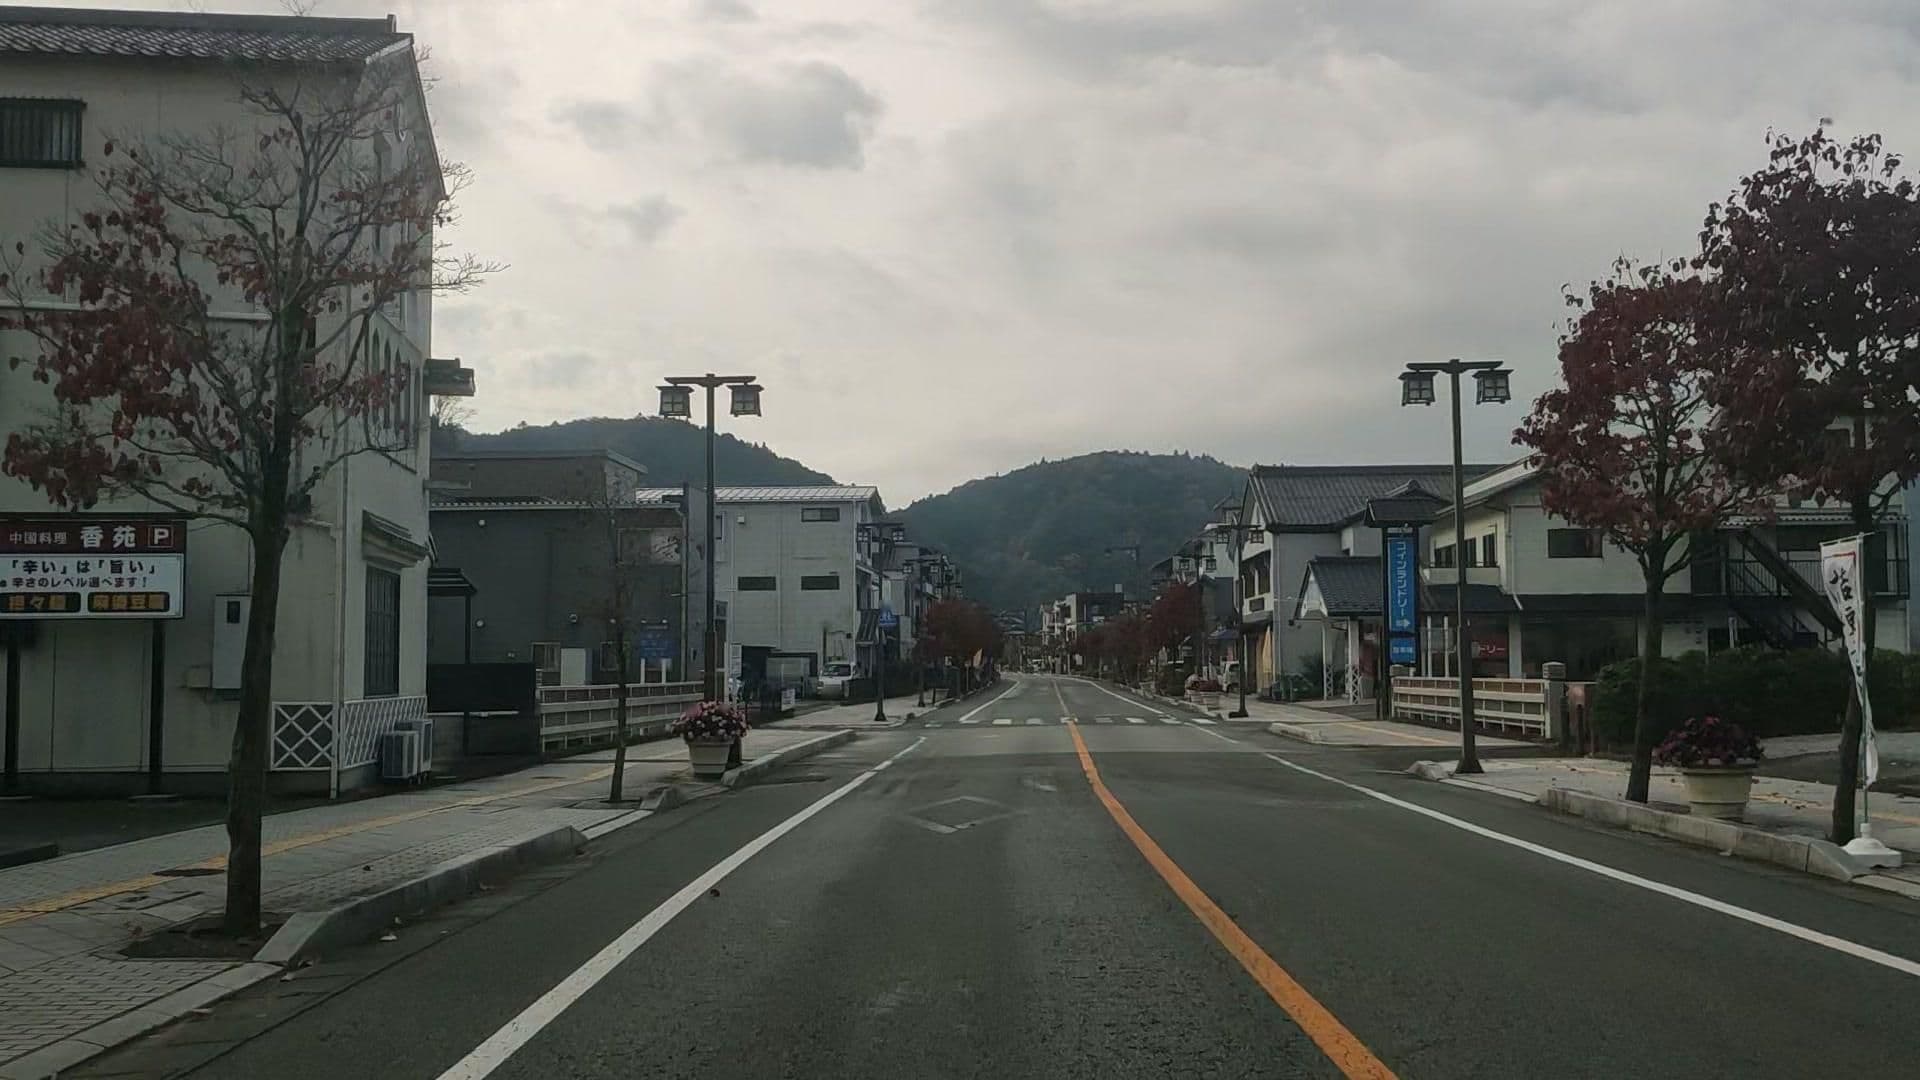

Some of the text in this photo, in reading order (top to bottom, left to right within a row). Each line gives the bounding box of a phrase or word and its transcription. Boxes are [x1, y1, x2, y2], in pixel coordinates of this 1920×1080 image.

[80, 525, 137, 548] 香苑
[154, 527, 169, 543] P
[1397, 541, 1408, 616] コインランドリー
